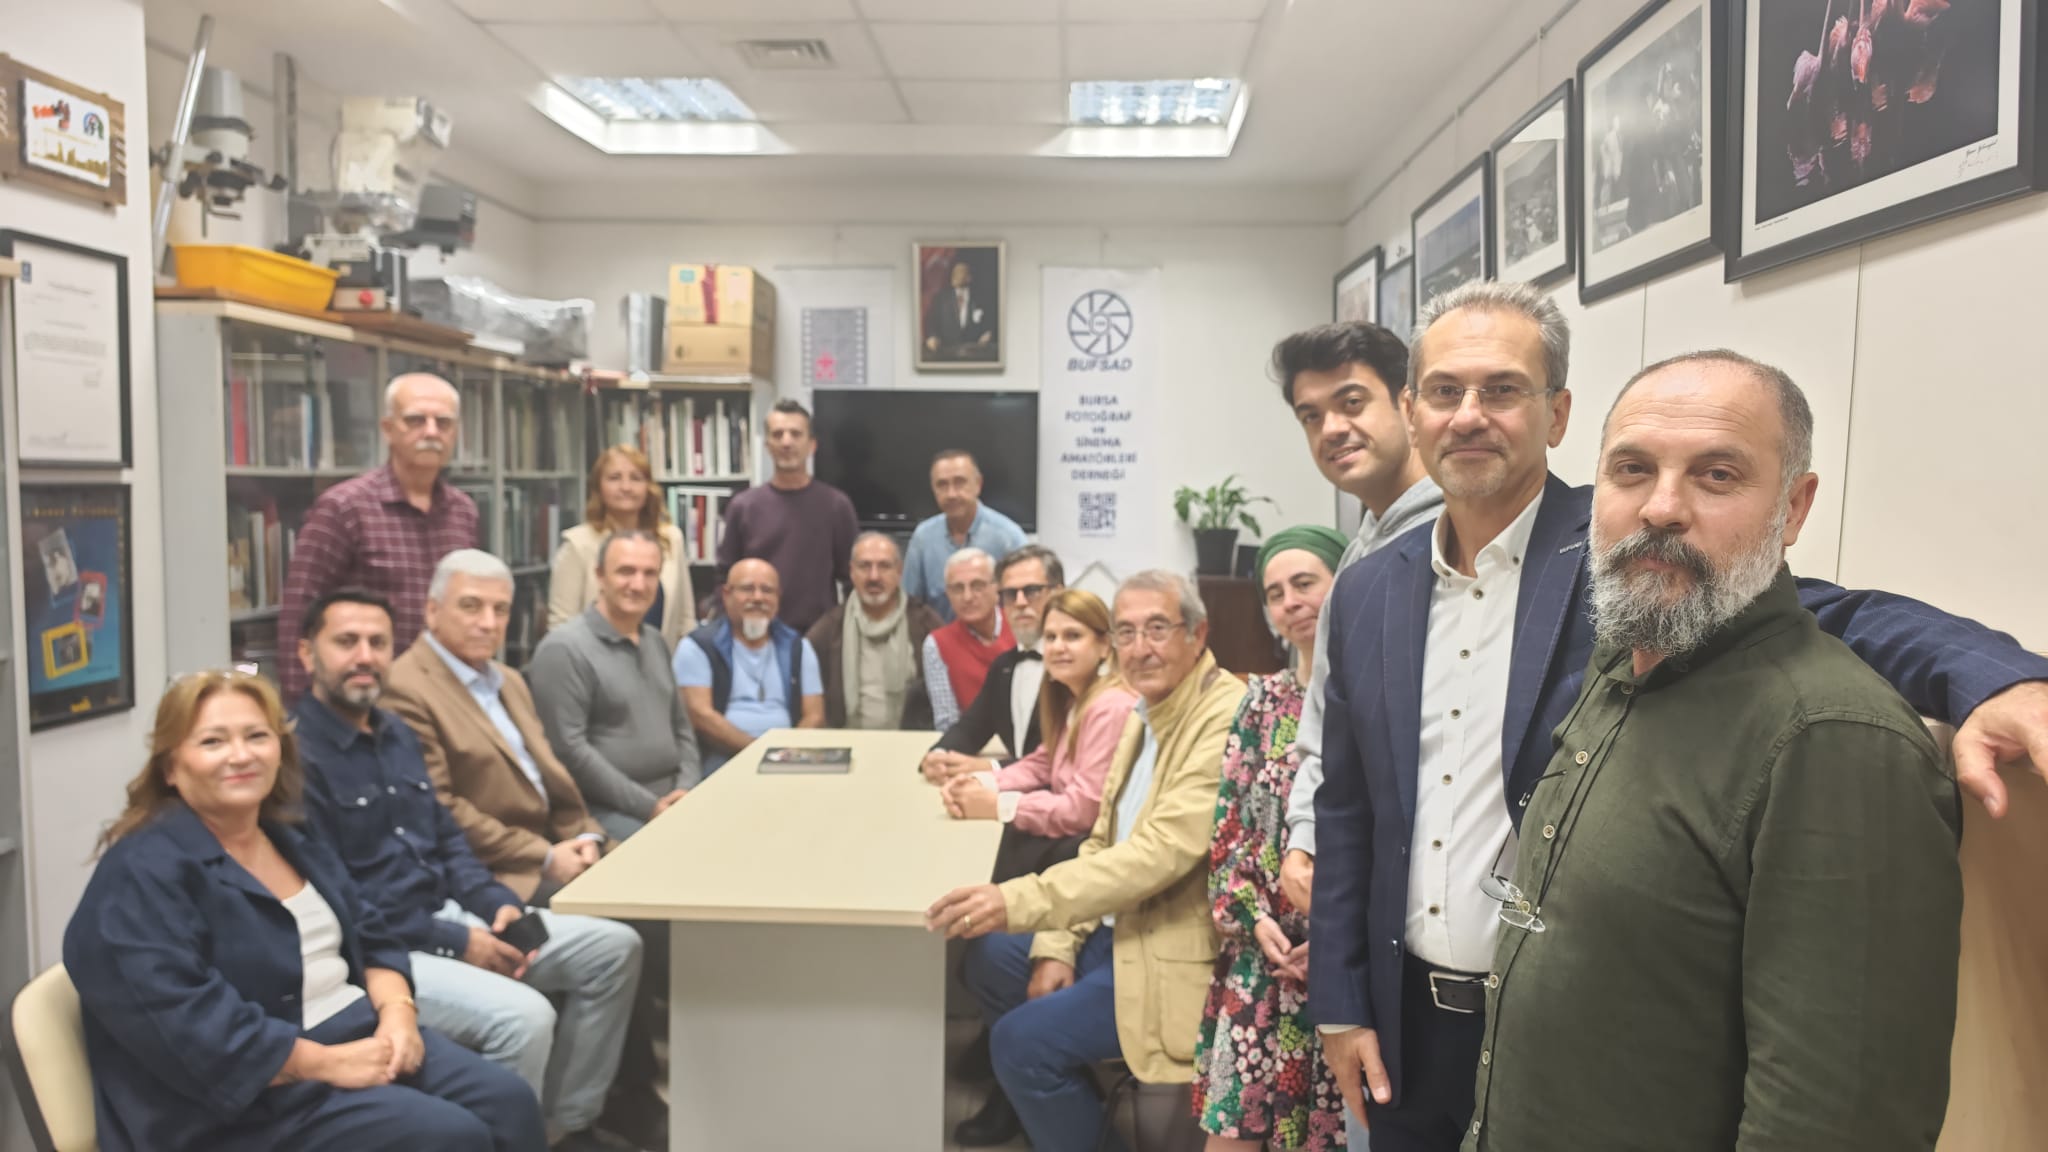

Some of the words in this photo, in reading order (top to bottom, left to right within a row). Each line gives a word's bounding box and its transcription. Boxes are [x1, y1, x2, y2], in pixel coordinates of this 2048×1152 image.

[1067, 357, 1133, 371] BUFSAD
[1079, 395, 1119, 406] BURSA
[1065, 410, 1132, 422] FOTOĞRAF
[1076, 436, 1121, 447] SİNEMA
[1071, 467, 1126, 480] DERNEĞİ
